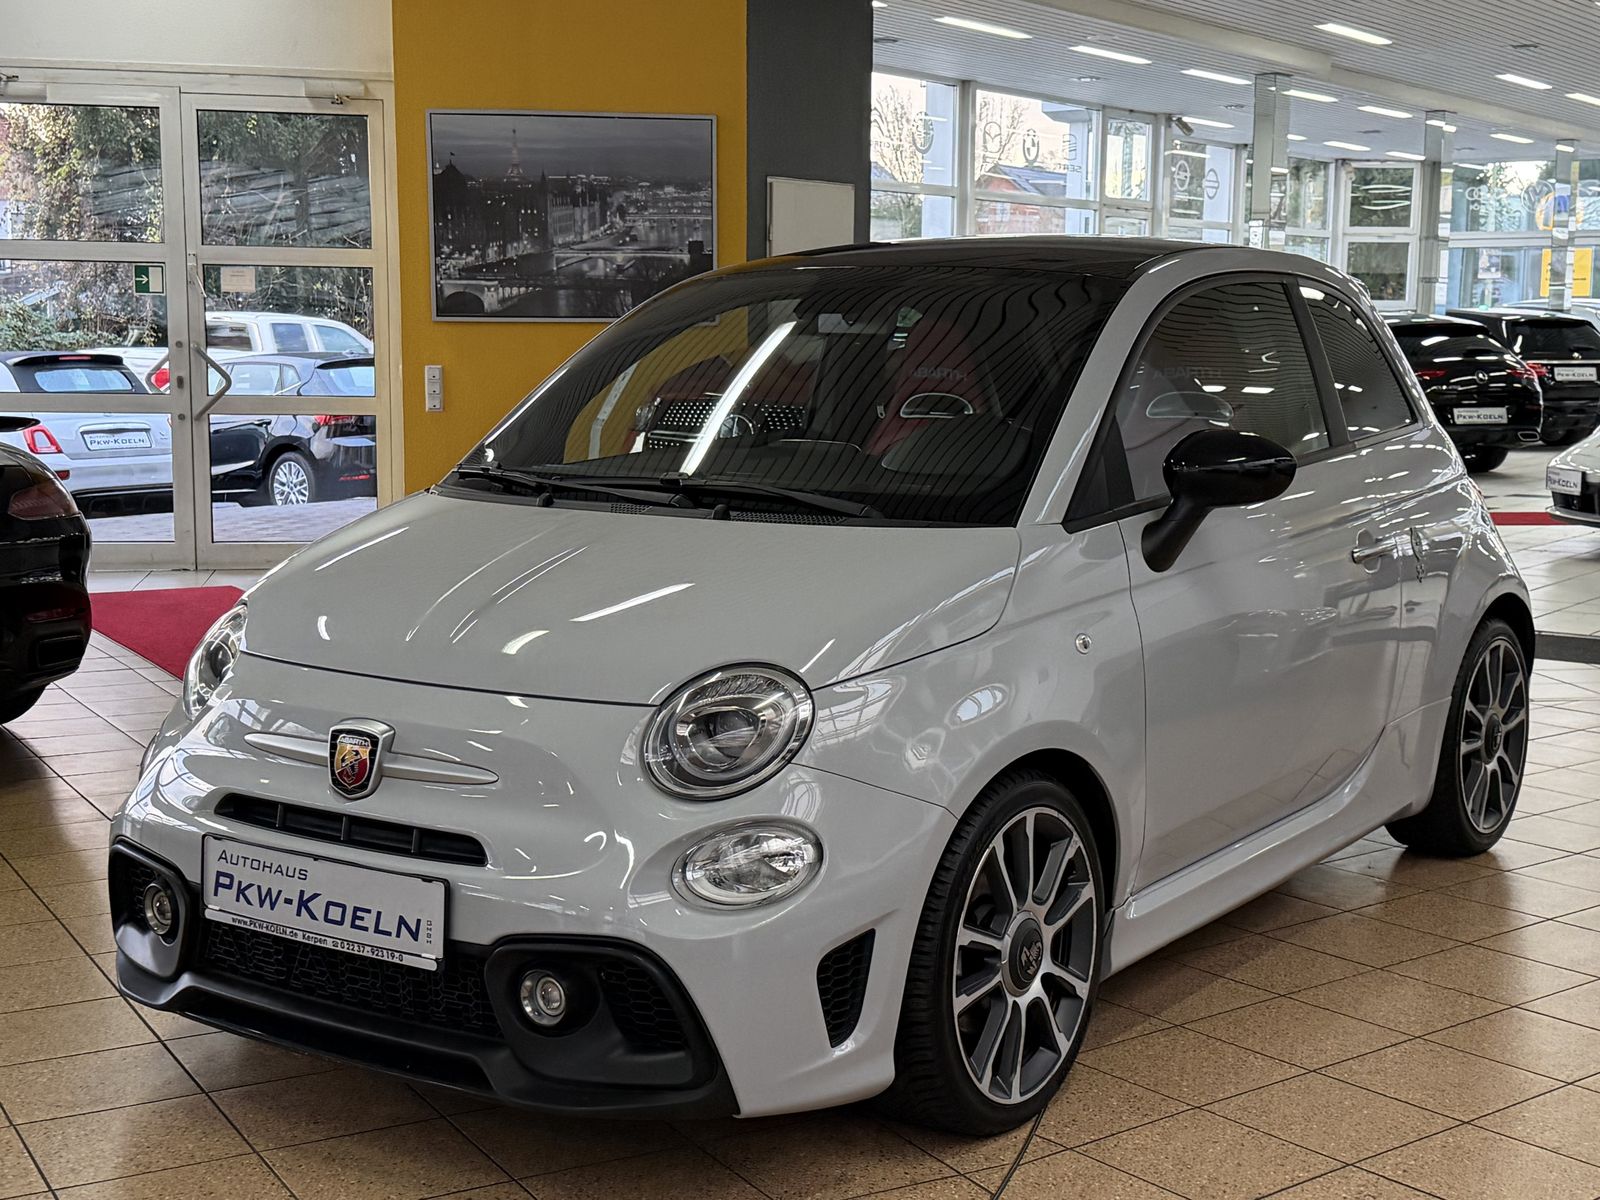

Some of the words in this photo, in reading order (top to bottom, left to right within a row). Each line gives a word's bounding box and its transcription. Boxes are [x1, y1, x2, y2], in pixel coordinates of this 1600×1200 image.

[217, 849, 309, 881] AUTOHAUS
[213, 870, 422, 942] PKW-KOELN
[302, 931, 328, 946] Kerpen
